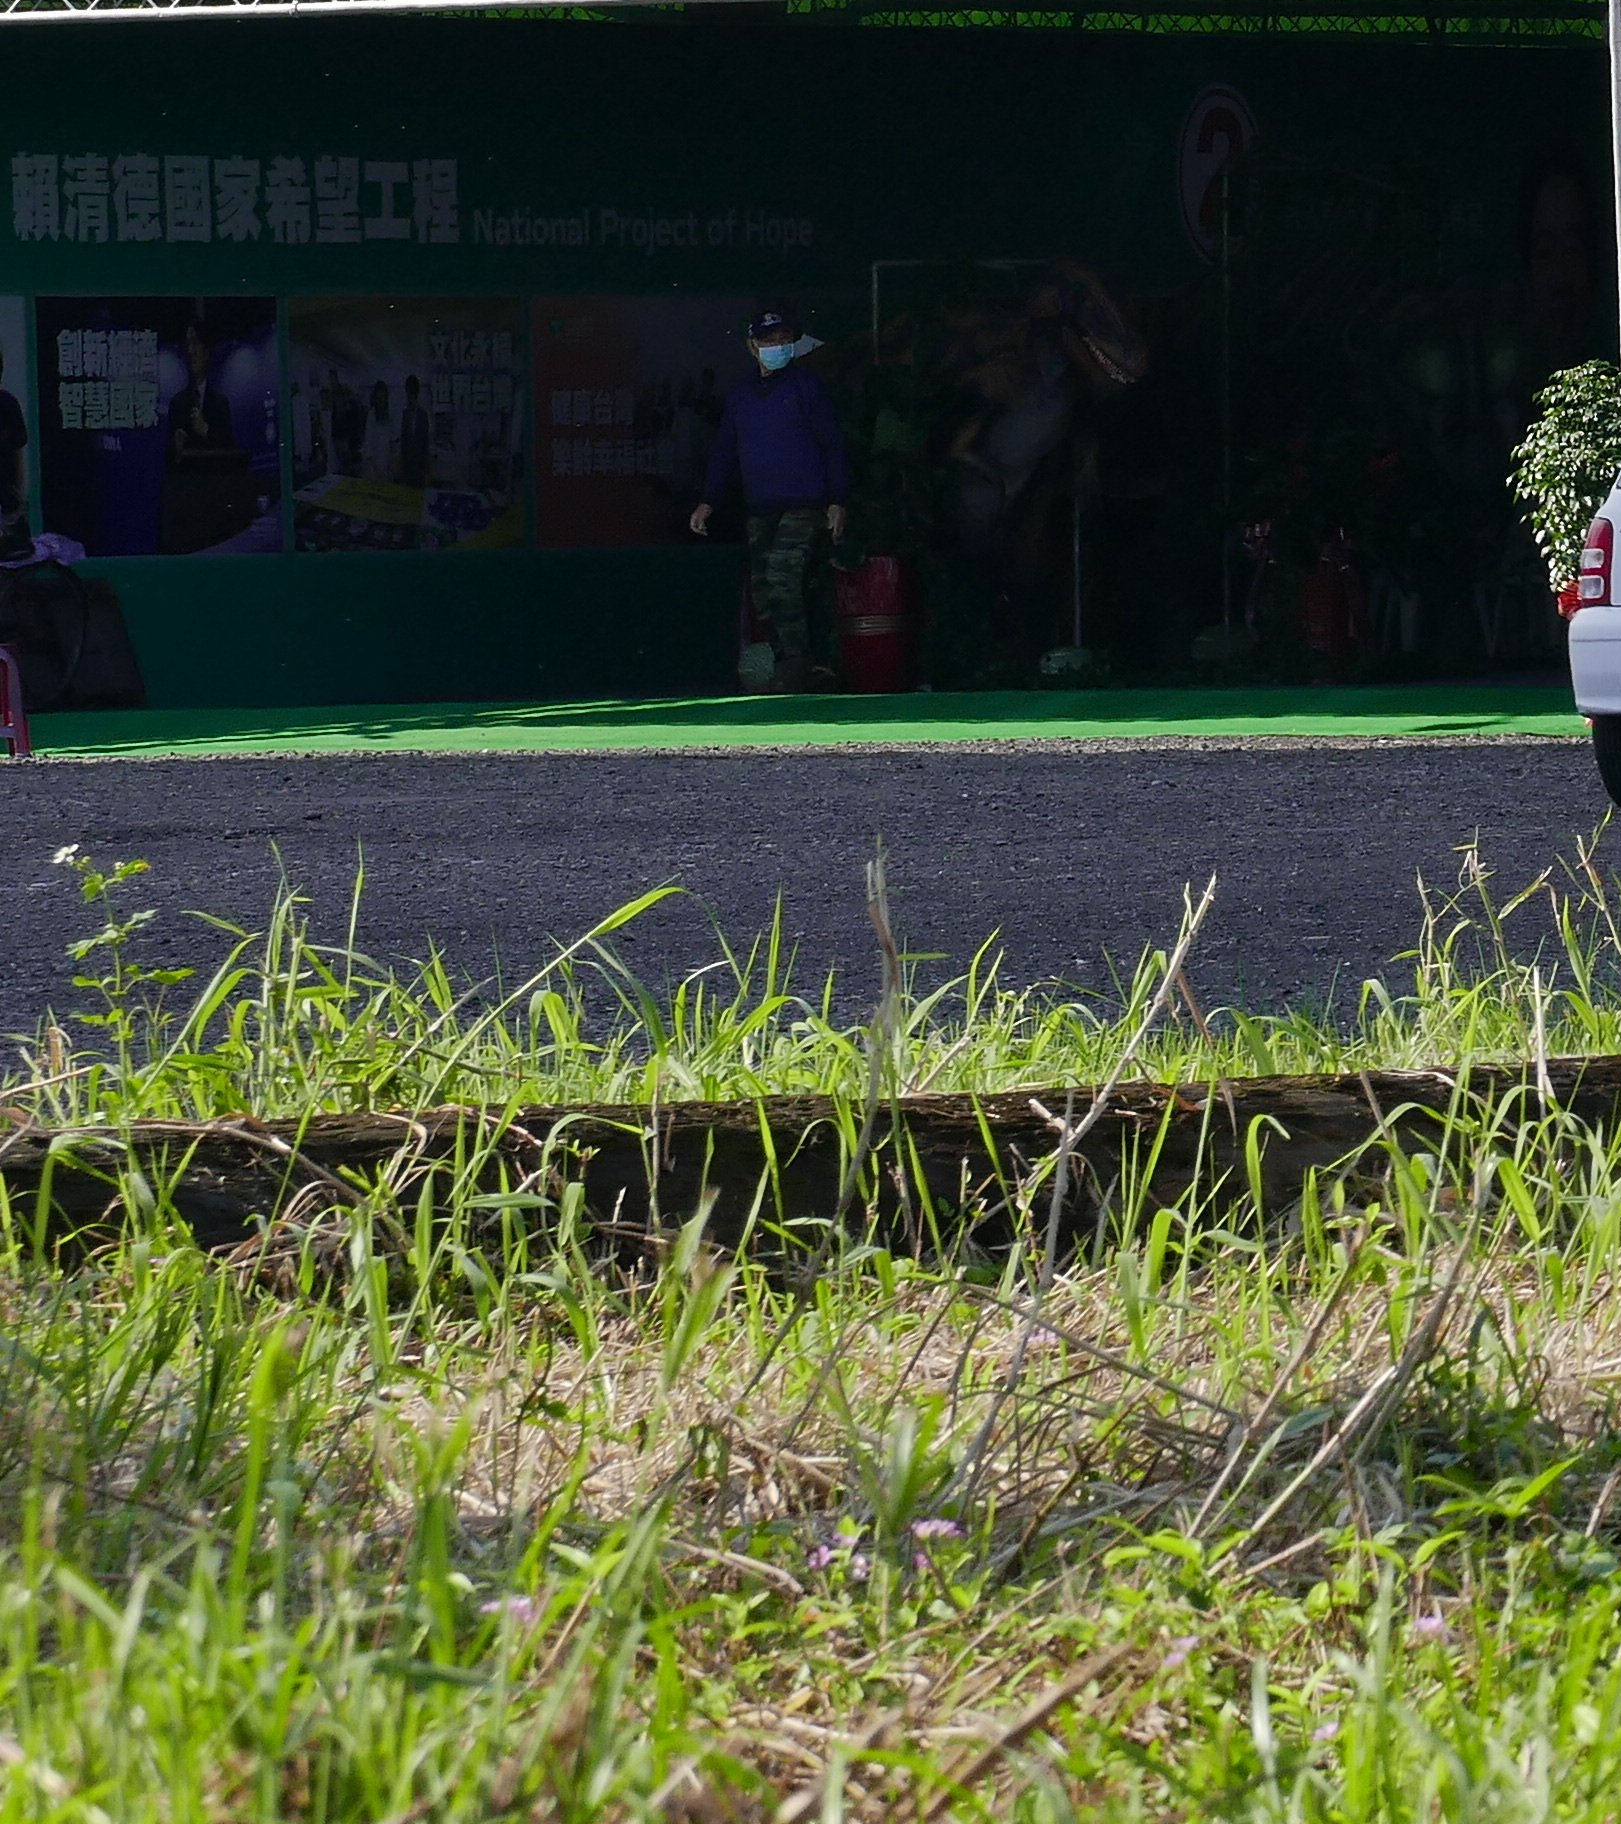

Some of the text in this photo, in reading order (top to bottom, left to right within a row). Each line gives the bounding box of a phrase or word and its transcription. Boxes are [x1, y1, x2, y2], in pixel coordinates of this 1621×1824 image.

[11, 151, 815, 257] 賴清德國家希望工程 National Project of Hope
